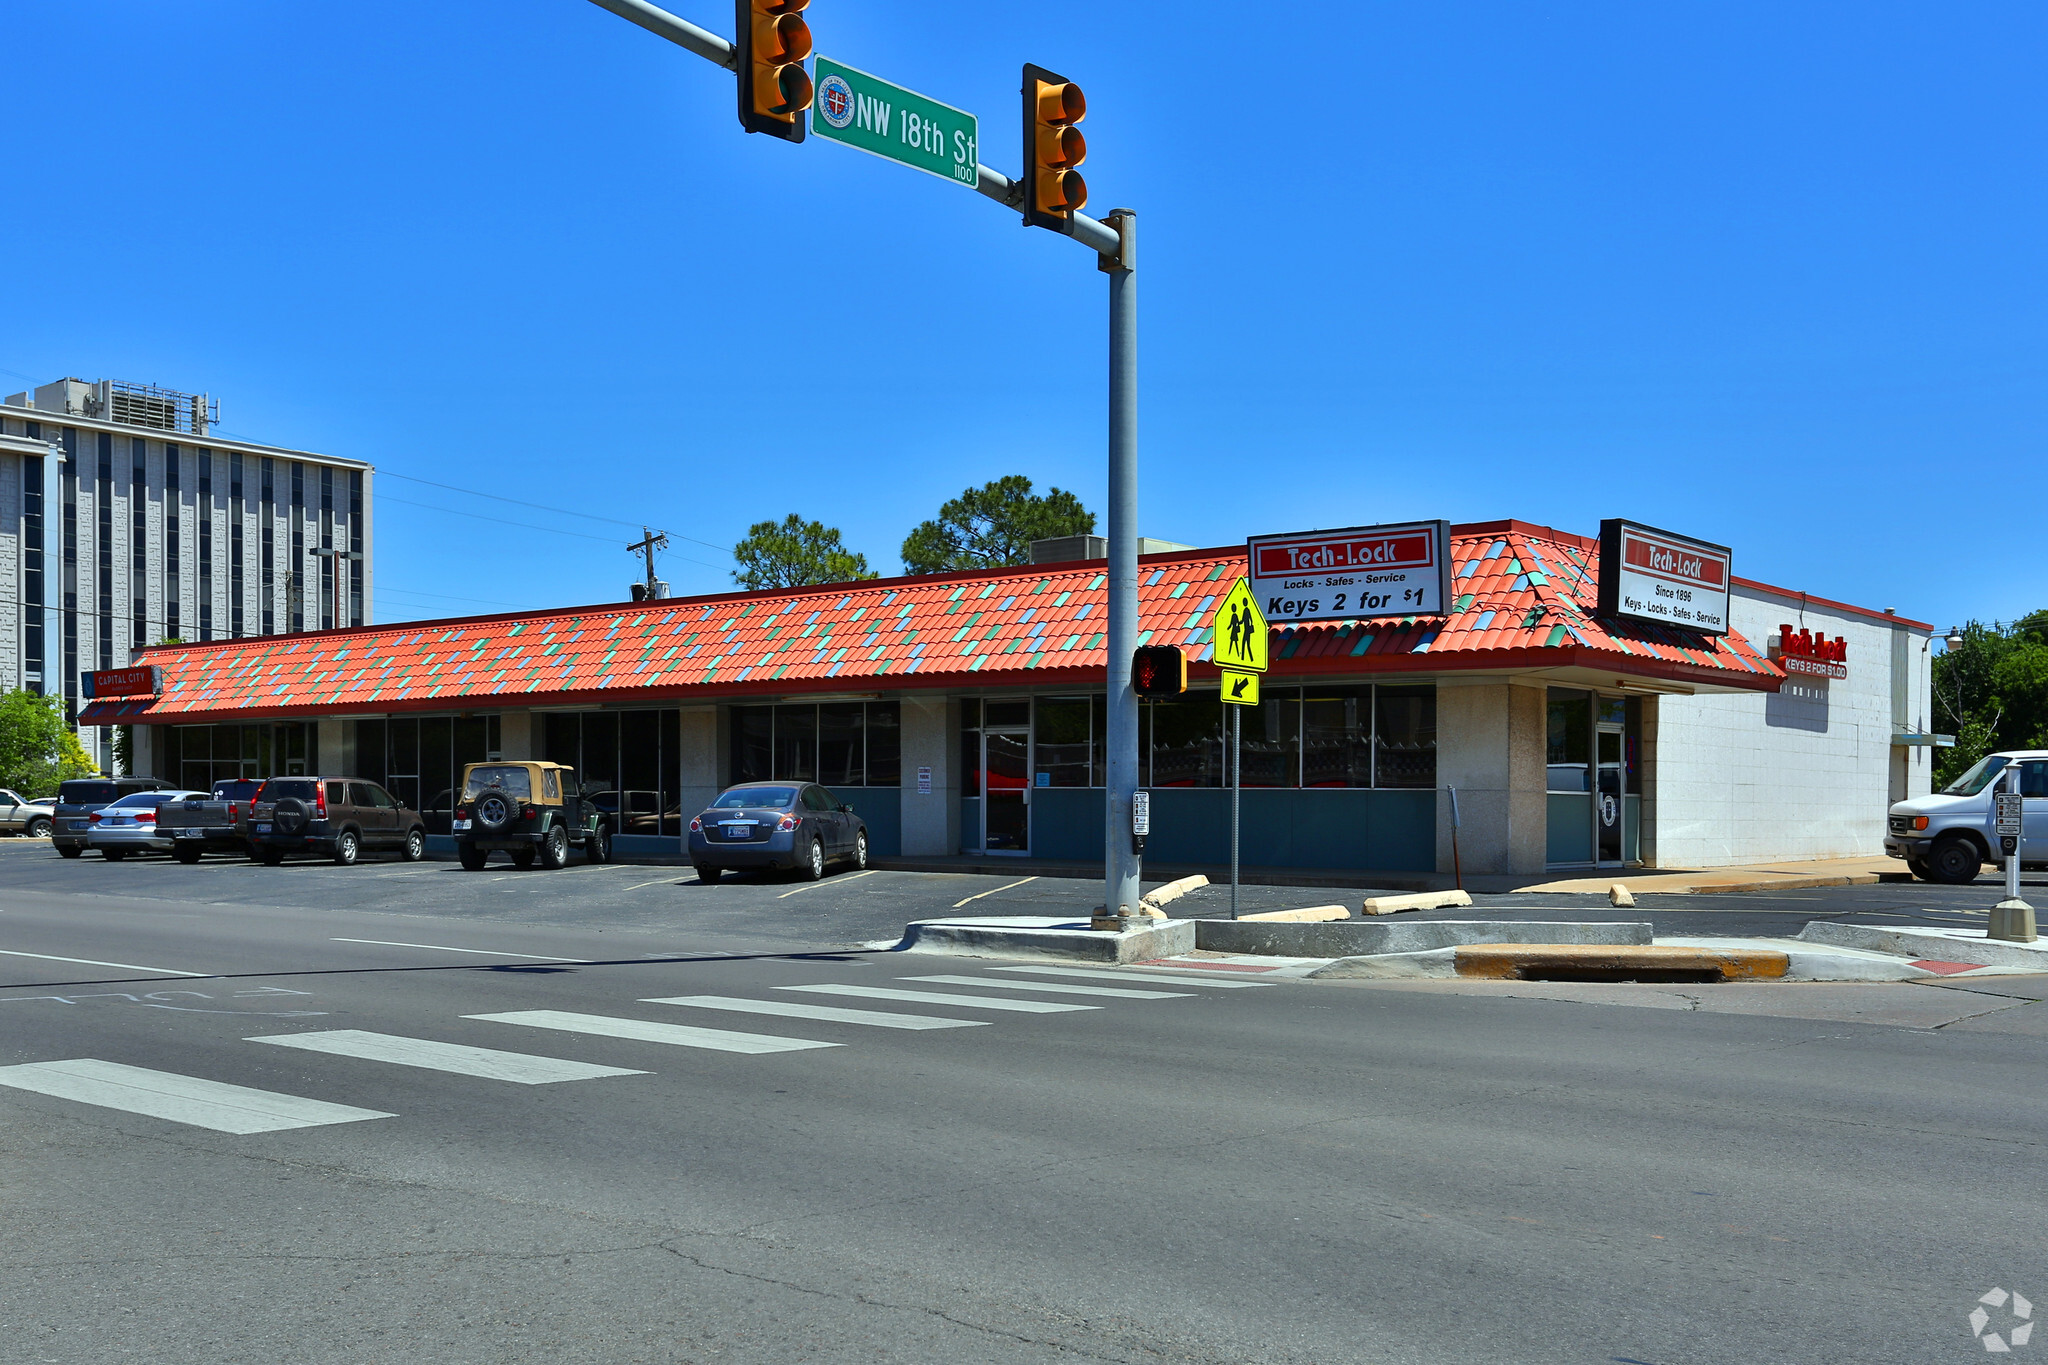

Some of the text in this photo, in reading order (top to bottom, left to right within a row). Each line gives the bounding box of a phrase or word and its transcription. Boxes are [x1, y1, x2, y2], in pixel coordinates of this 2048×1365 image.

[857, 92, 975, 168] NW 18th St
[954, 164, 973, 182] 1100
[1287, 541, 1396, 568] Tech-Lock
[1649, 545, 1702, 578] Tech-Lock
[1284, 580, 1314, 589] Locks
[1326, 576, 1354, 586] Safes
[1366, 573, 1406, 584] Service
[1267, 588, 1424, 617] Keys 2 for $1
[1656, 584, 1692, 602] Since 1896
[1624, 596, 1642, 612] Keys
[1648, 600, 1668, 615] Locks
[1672, 606, 1691, 620] Safes
[1696, 610, 1720, 625] Service
[1786, 658, 1804, 672] KEYS
[1806, 662, 1812, 672] 2
[1812, 662, 1826, 674] FOR
[98, 672, 144, 686] CAPITAL CITY
